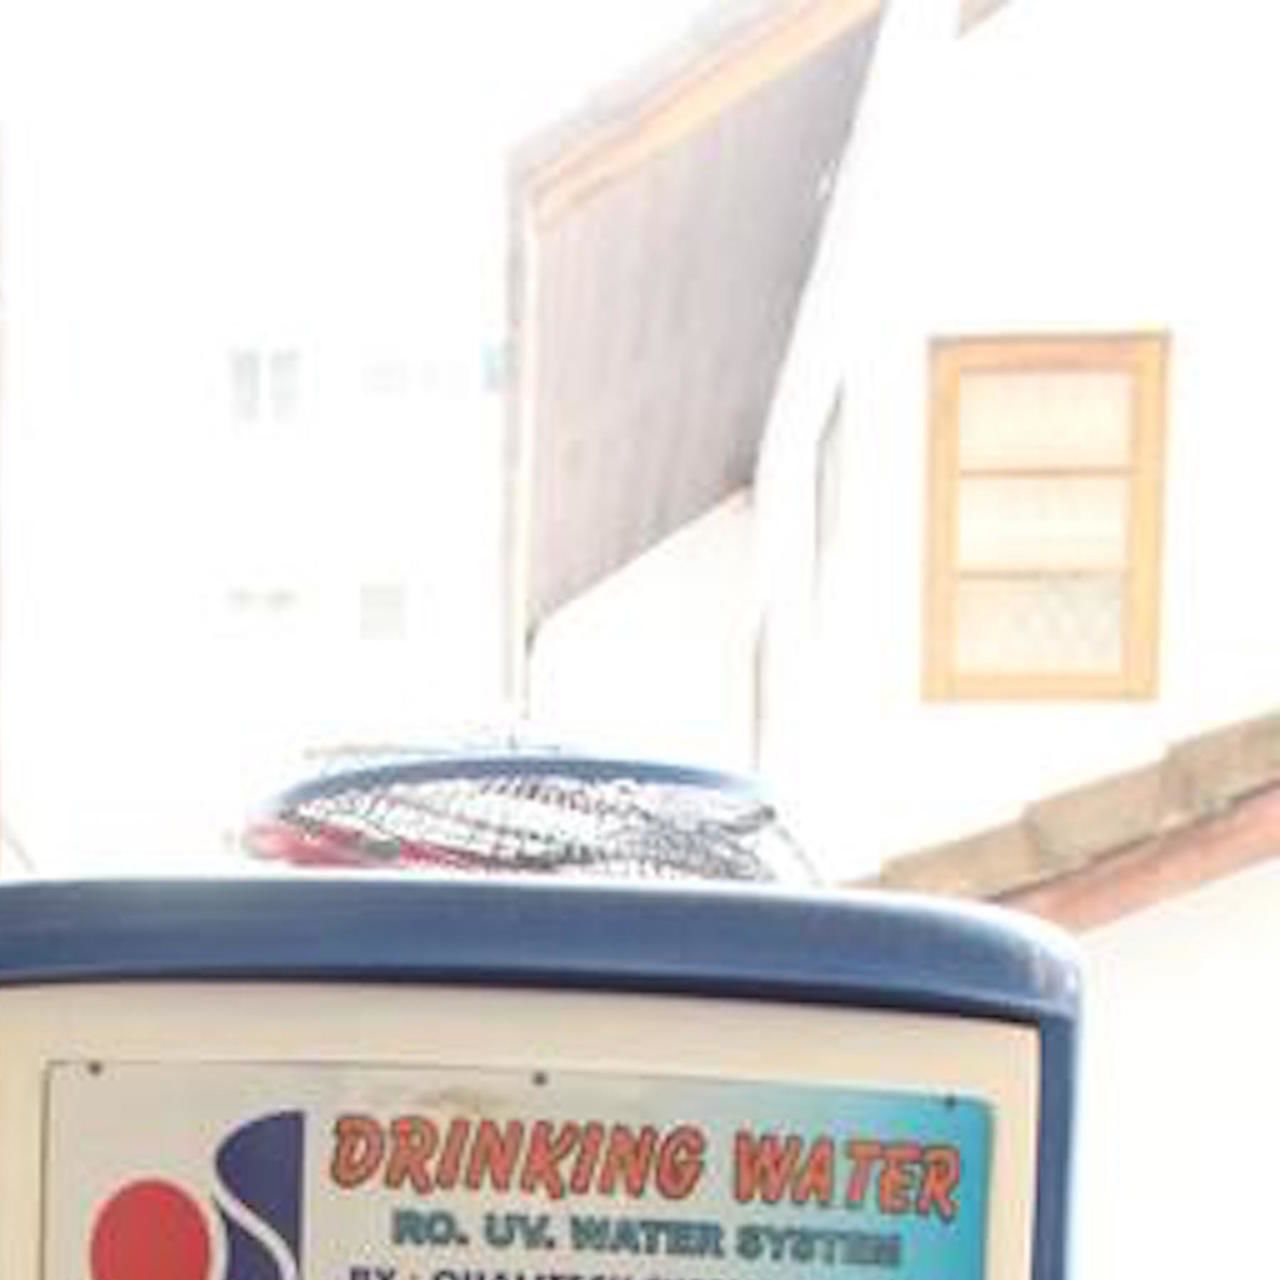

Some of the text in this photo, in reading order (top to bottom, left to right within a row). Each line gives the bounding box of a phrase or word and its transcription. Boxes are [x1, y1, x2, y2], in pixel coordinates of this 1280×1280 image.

[330, 1114, 962, 1223] DRINKING WATER
[570, 1216, 724, 1258] WATER
[736, 1224, 902, 1268] SYSTEM
